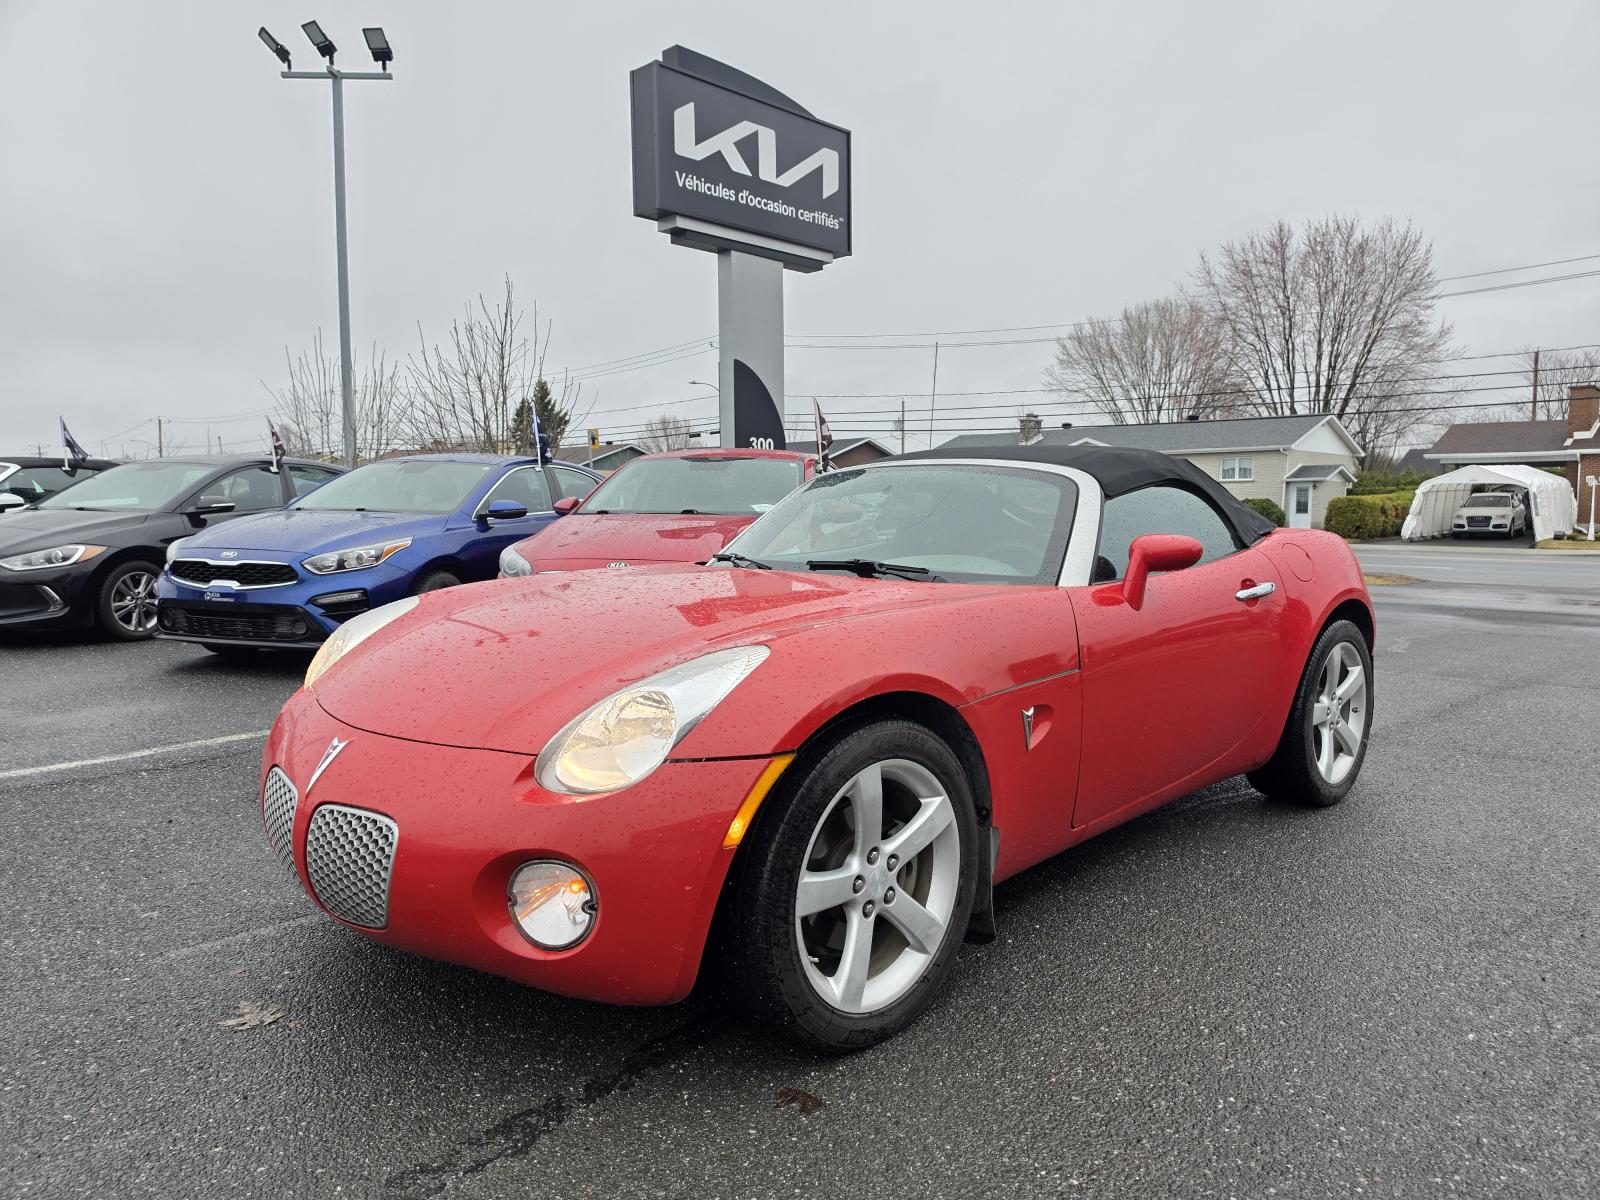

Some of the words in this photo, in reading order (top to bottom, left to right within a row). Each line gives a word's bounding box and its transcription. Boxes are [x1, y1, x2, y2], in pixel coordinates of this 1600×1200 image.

[674, 102, 839, 199] KIA
[675, 170, 736, 201] Véhicules
[738, 189, 796, 218] d'occasion
[798, 208, 839, 229] certifiés
[749, 436, 774, 450] 300
